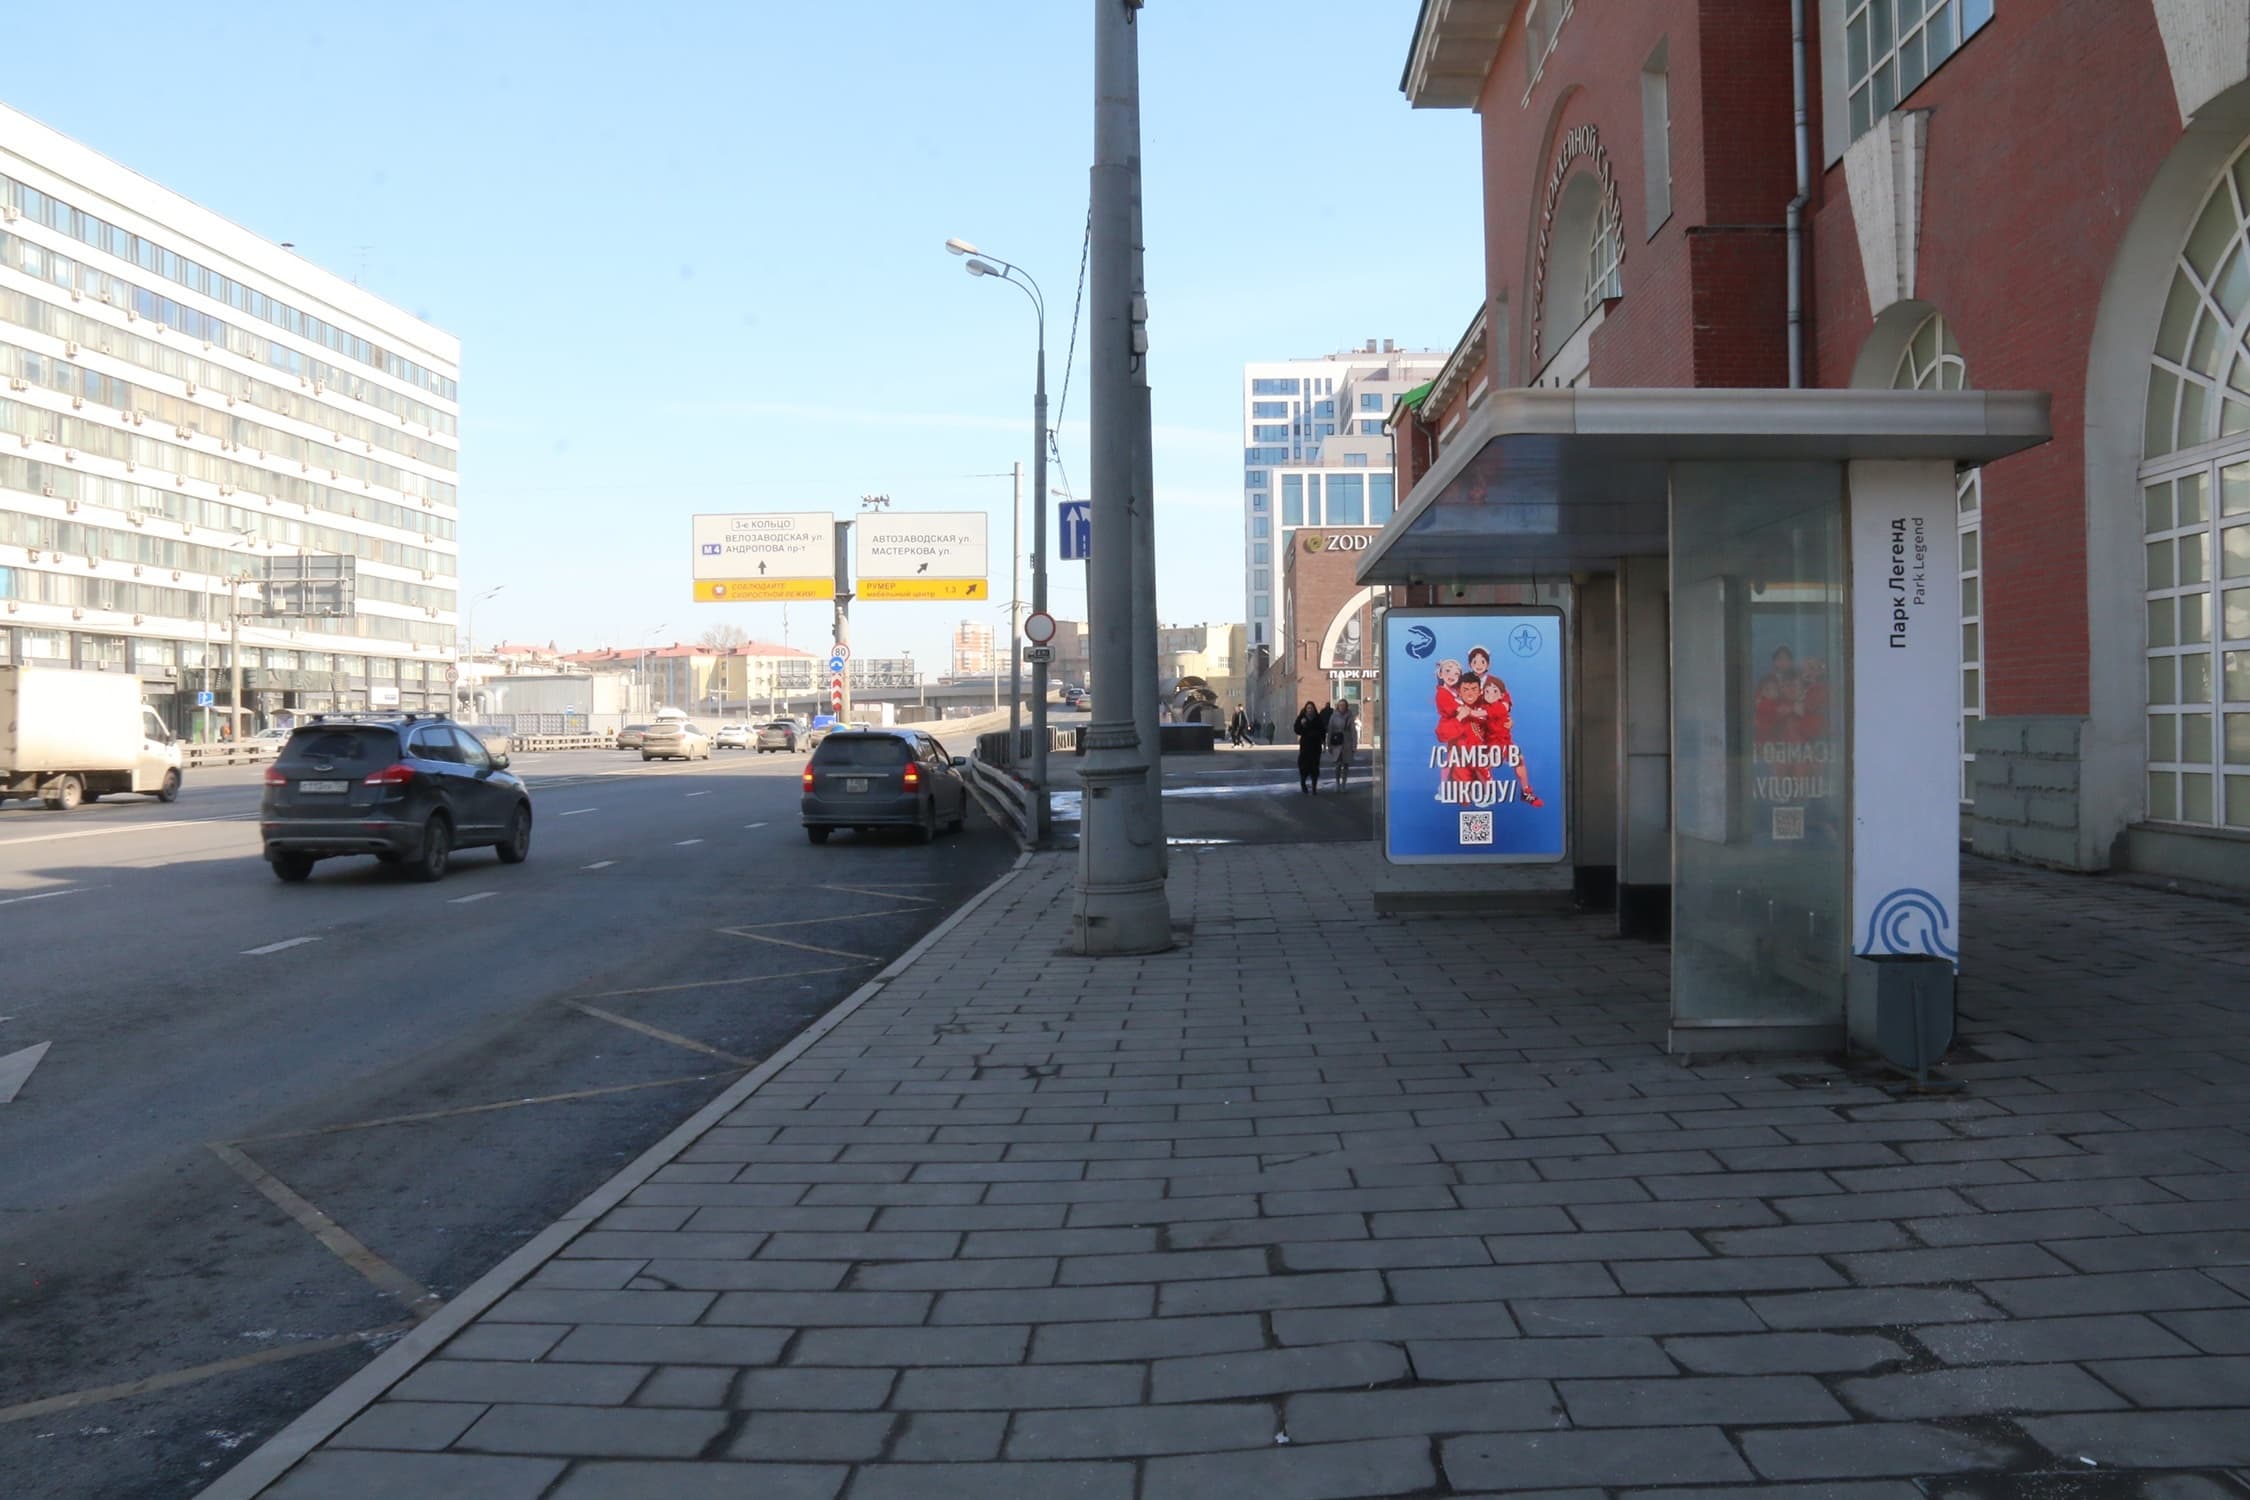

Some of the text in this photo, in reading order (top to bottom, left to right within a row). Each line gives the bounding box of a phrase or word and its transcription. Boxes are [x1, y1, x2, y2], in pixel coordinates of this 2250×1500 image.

[1545, 125, 1598, 220] ОККЕЙНОЙ
[751, 519, 791, 530] КОЛЬЦО
[725, 533, 809, 543] ВЕЛОЗАВОДСКАЯ
[872, 534, 956, 543] АВТОЗАВОДСКАЯ
[725, 544, 785, 554] АНДРОПОВА
[871, 546, 936, 556] МАСТЕРКОВА
[1911, 517, 1928, 605] Park Legend
[1888, 517, 1910, 649] Парк Легенд
[835, 647, 847, 657] 80
[1329, 669, 1360, 680] ПАРК
[1440, 779, 1517, 804] ШКОЛУ/
